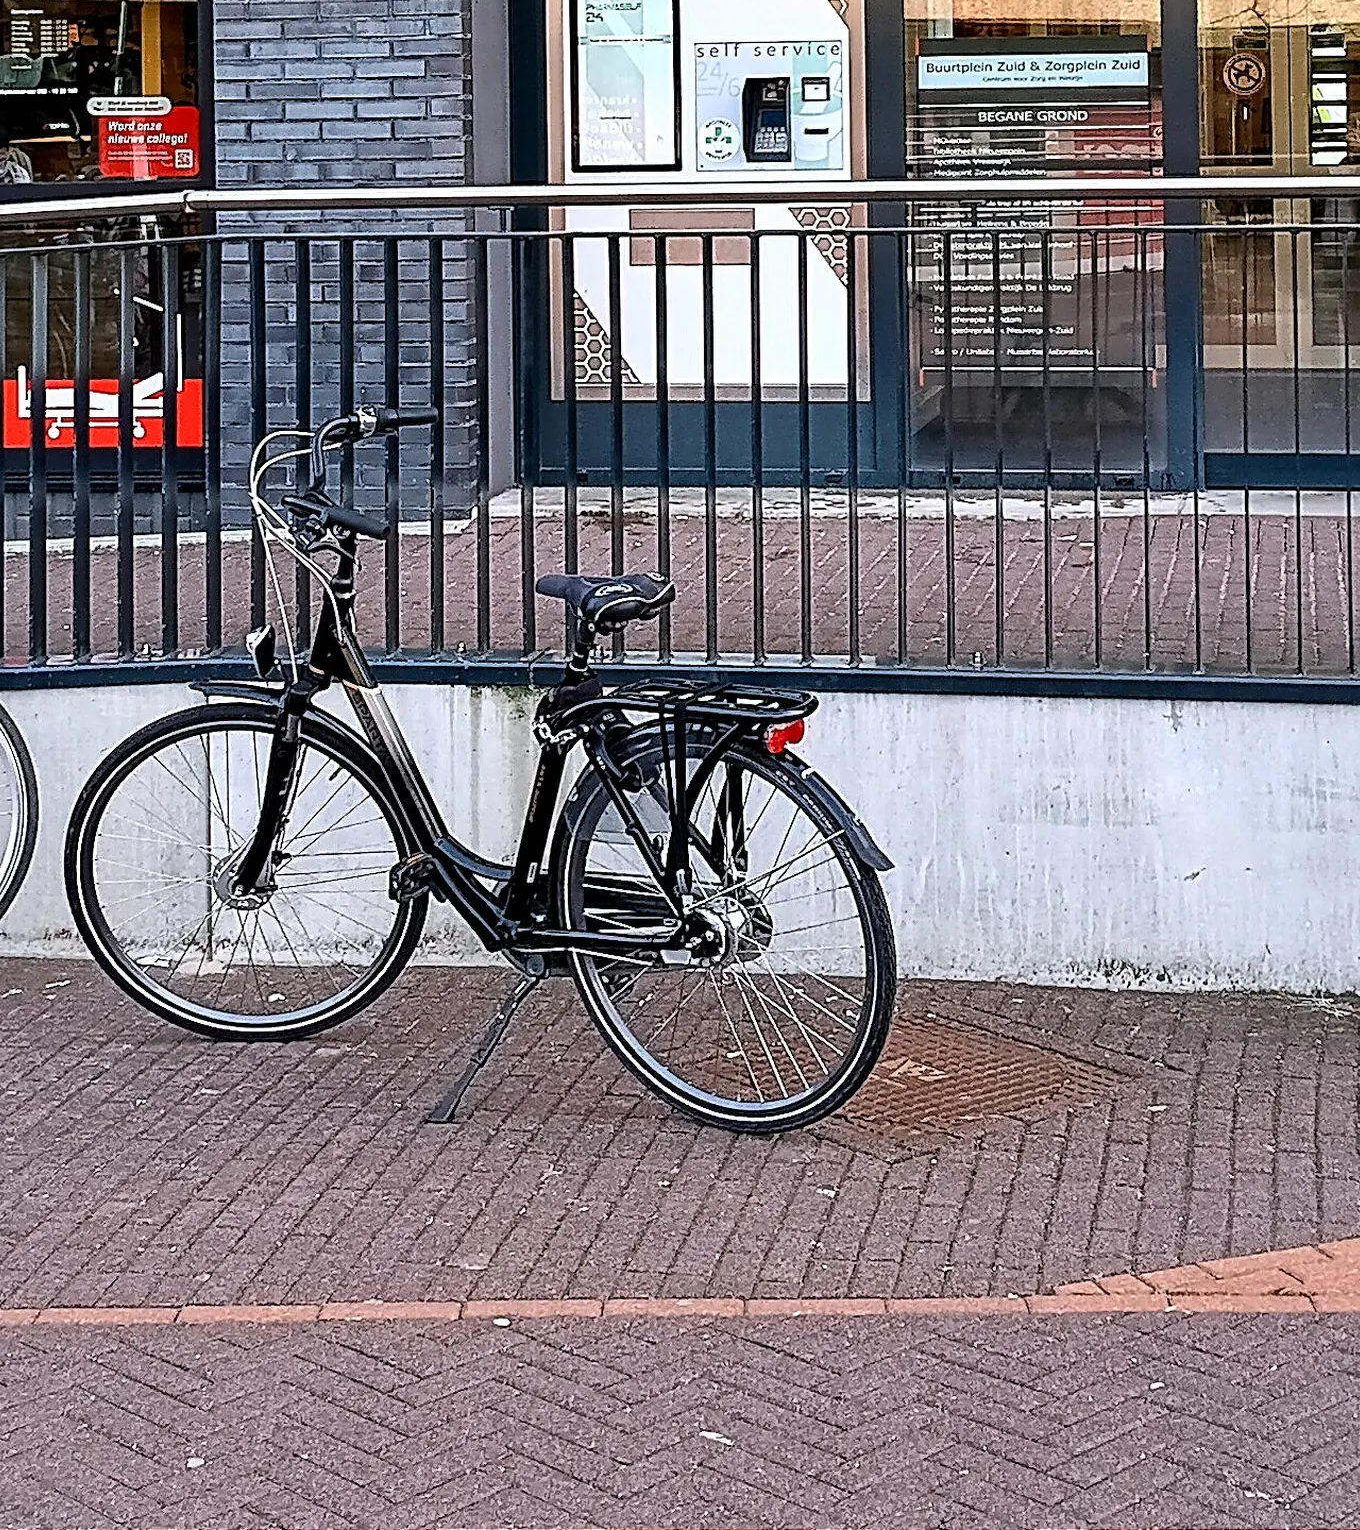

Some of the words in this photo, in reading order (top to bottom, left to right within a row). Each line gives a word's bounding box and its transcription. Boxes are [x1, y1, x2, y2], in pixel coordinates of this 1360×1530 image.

[697, 42, 740, 57] self
[753, 41, 840, 57] service
[926, 62, 993, 74] Buurtplein
[997, 61, 1026, 72] Zuid
[1030, 61, 1041, 71] &
[1044, 60, 1107, 73] Zorgplein
[1111, 59, 1141, 71] Zuid
[977, 111, 1035, 123] BEGANE
[1036, 110, 1089, 122] GROND
[107, 121, 136, 131] Word
[136, 122, 163, 132] onze
[107, 133, 145, 144] nieuwe
